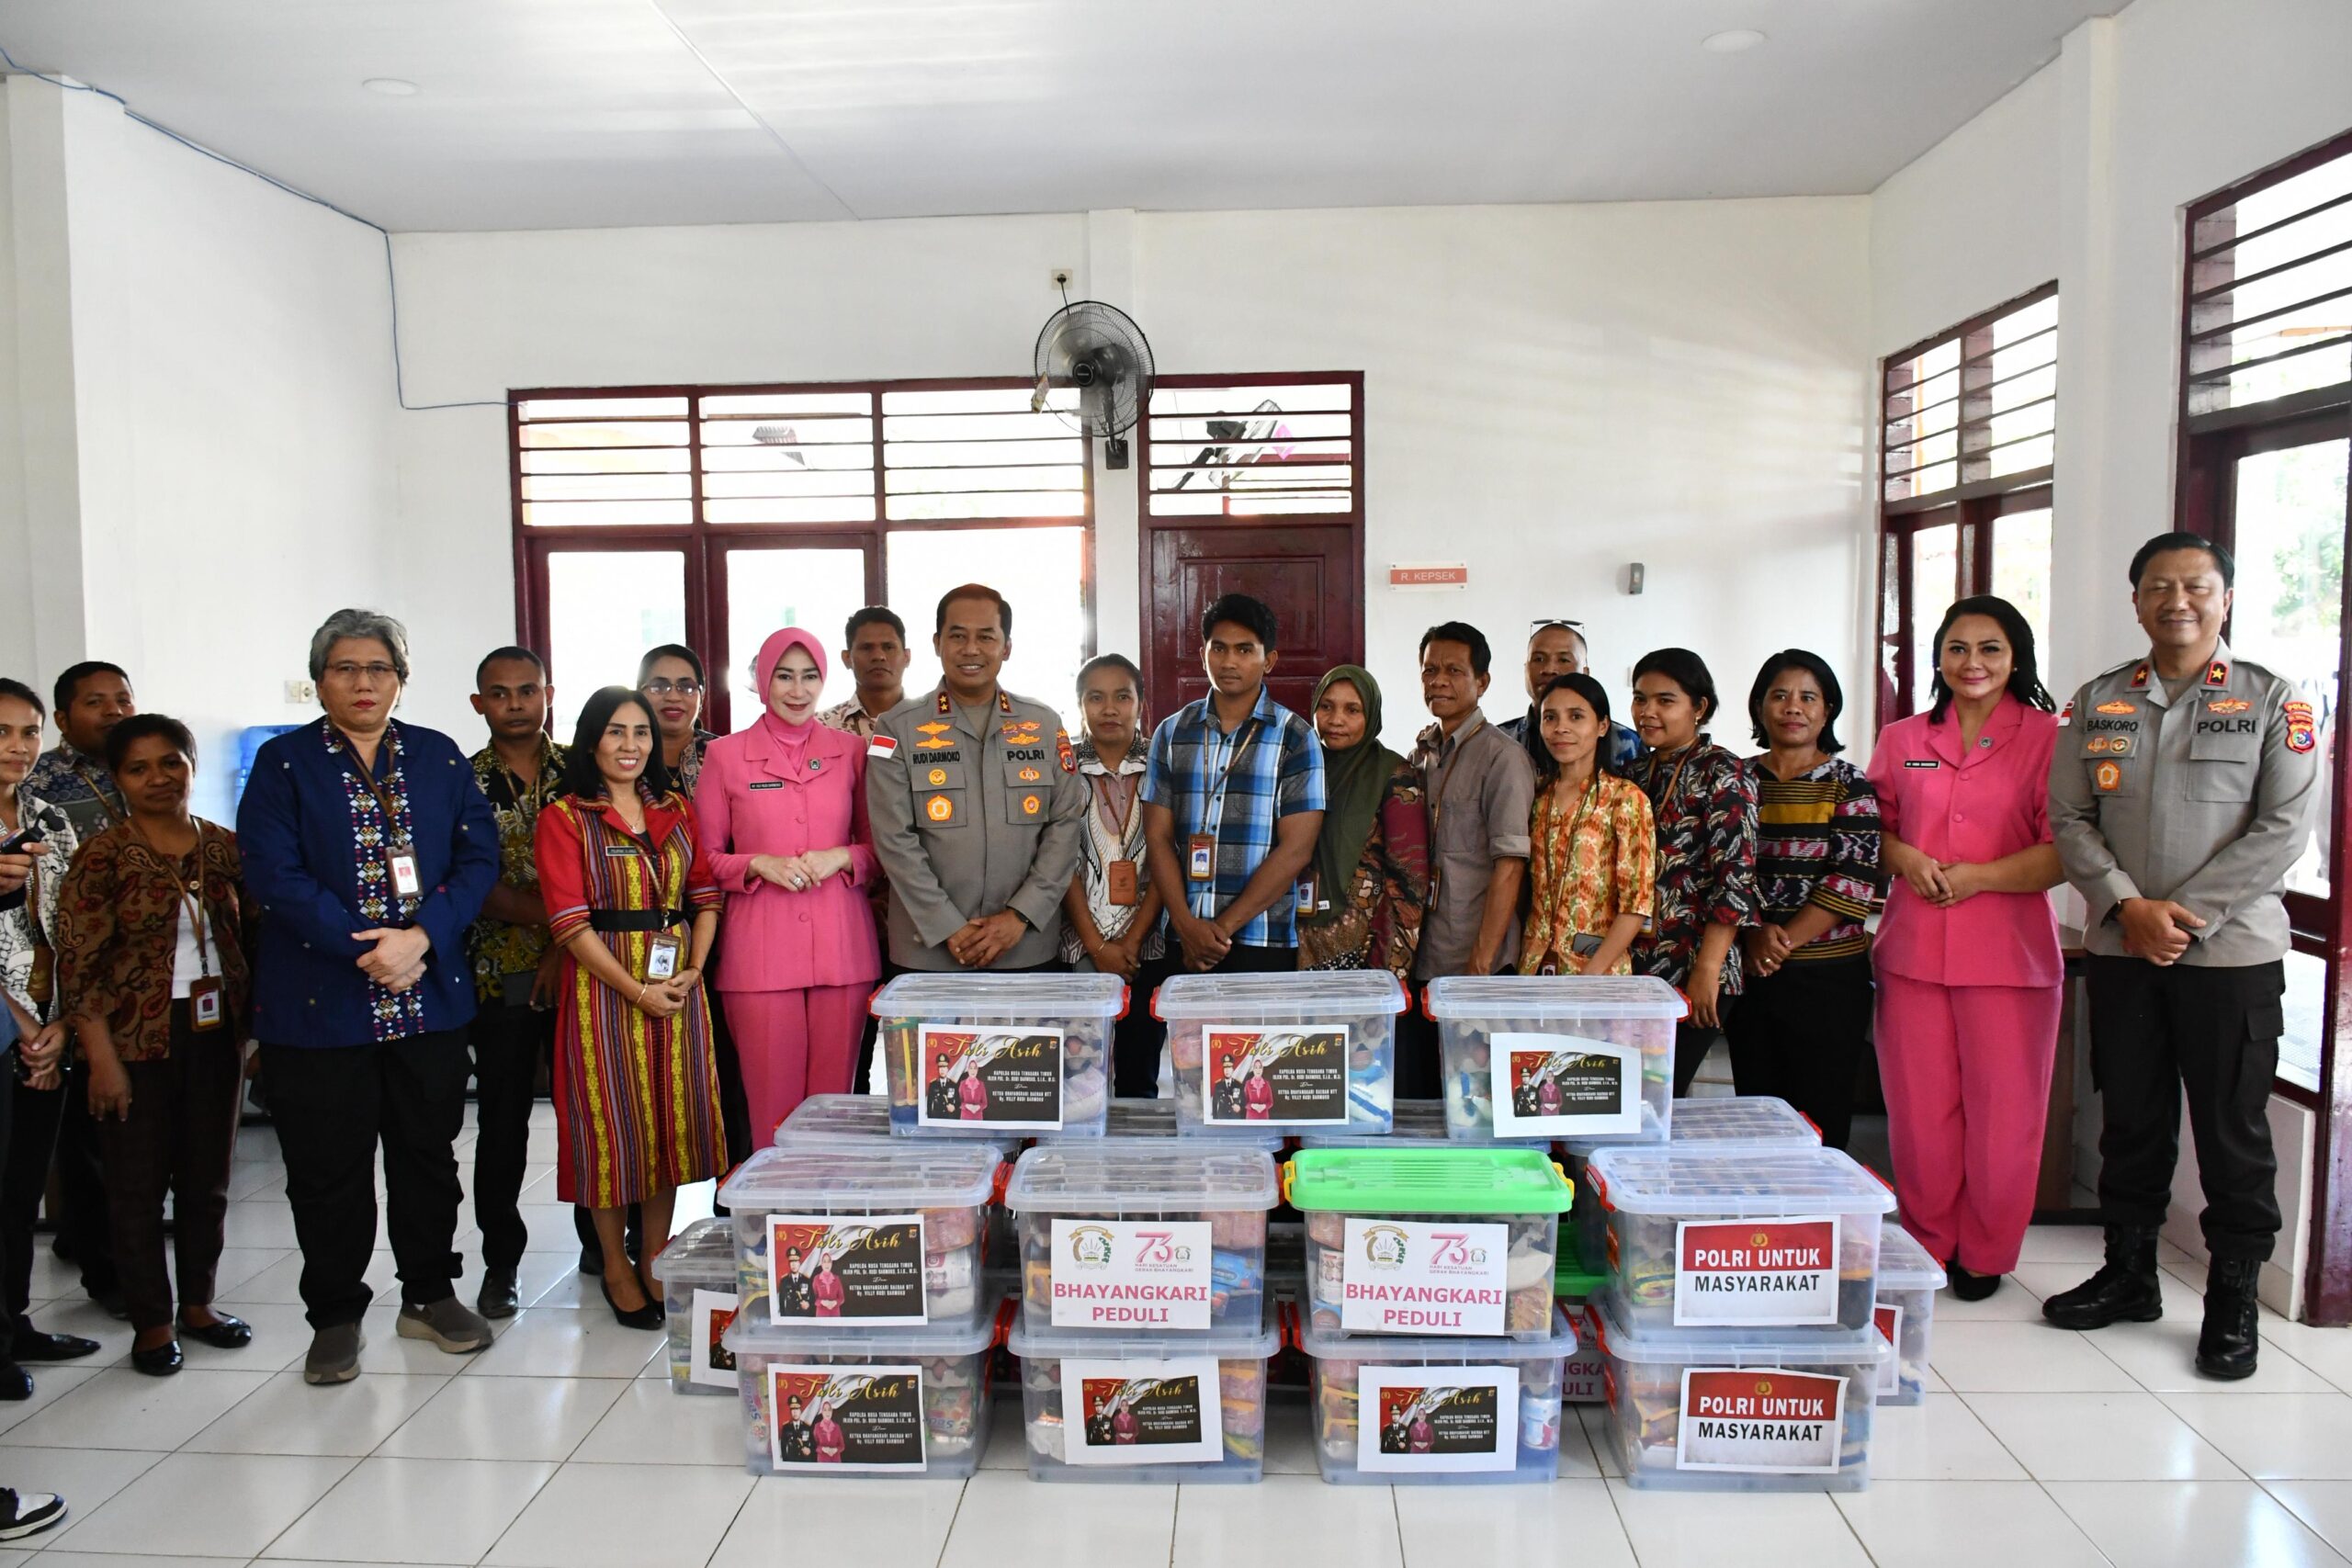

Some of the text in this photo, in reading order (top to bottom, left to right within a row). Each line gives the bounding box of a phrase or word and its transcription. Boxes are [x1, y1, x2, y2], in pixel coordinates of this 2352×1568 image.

[1414, 571, 1456, 581] KEPSEK
[2086, 719, 2139, 733] BASKORO
[2197, 719, 2256, 734] POLRI
[913, 751, 960, 764] RUDI DARMOKO
[1007, 749, 1045, 761] POLRI
[944, 1034, 1042, 1058] Tali Asih
[1227, 1035, 1328, 1057] Tali Asih
[794, 1226, 900, 1250] Tali Asih
[1135, 1231, 1174, 1263] 73
[1430, 1233, 1469, 1265] 73
[1694, 1247, 1820, 1268] POLRI UNTUK
[1054, 1283, 1207, 1301] BHAYANGKARI
[1695, 1274, 1820, 1292] MASYARAKAT
[1346, 1283, 1502, 1304] BHAYANGKARI
[1092, 1307, 1169, 1323] PEDULI
[1384, 1309, 1462, 1326] PEDULI
[795, 1377, 899, 1400] Tali Asih
[1563, 1382, 1594, 1396] ULI
[1700, 1396, 1824, 1416] POLRI UNTUK
[1698, 1422, 1823, 1440] MASYARAKAT
